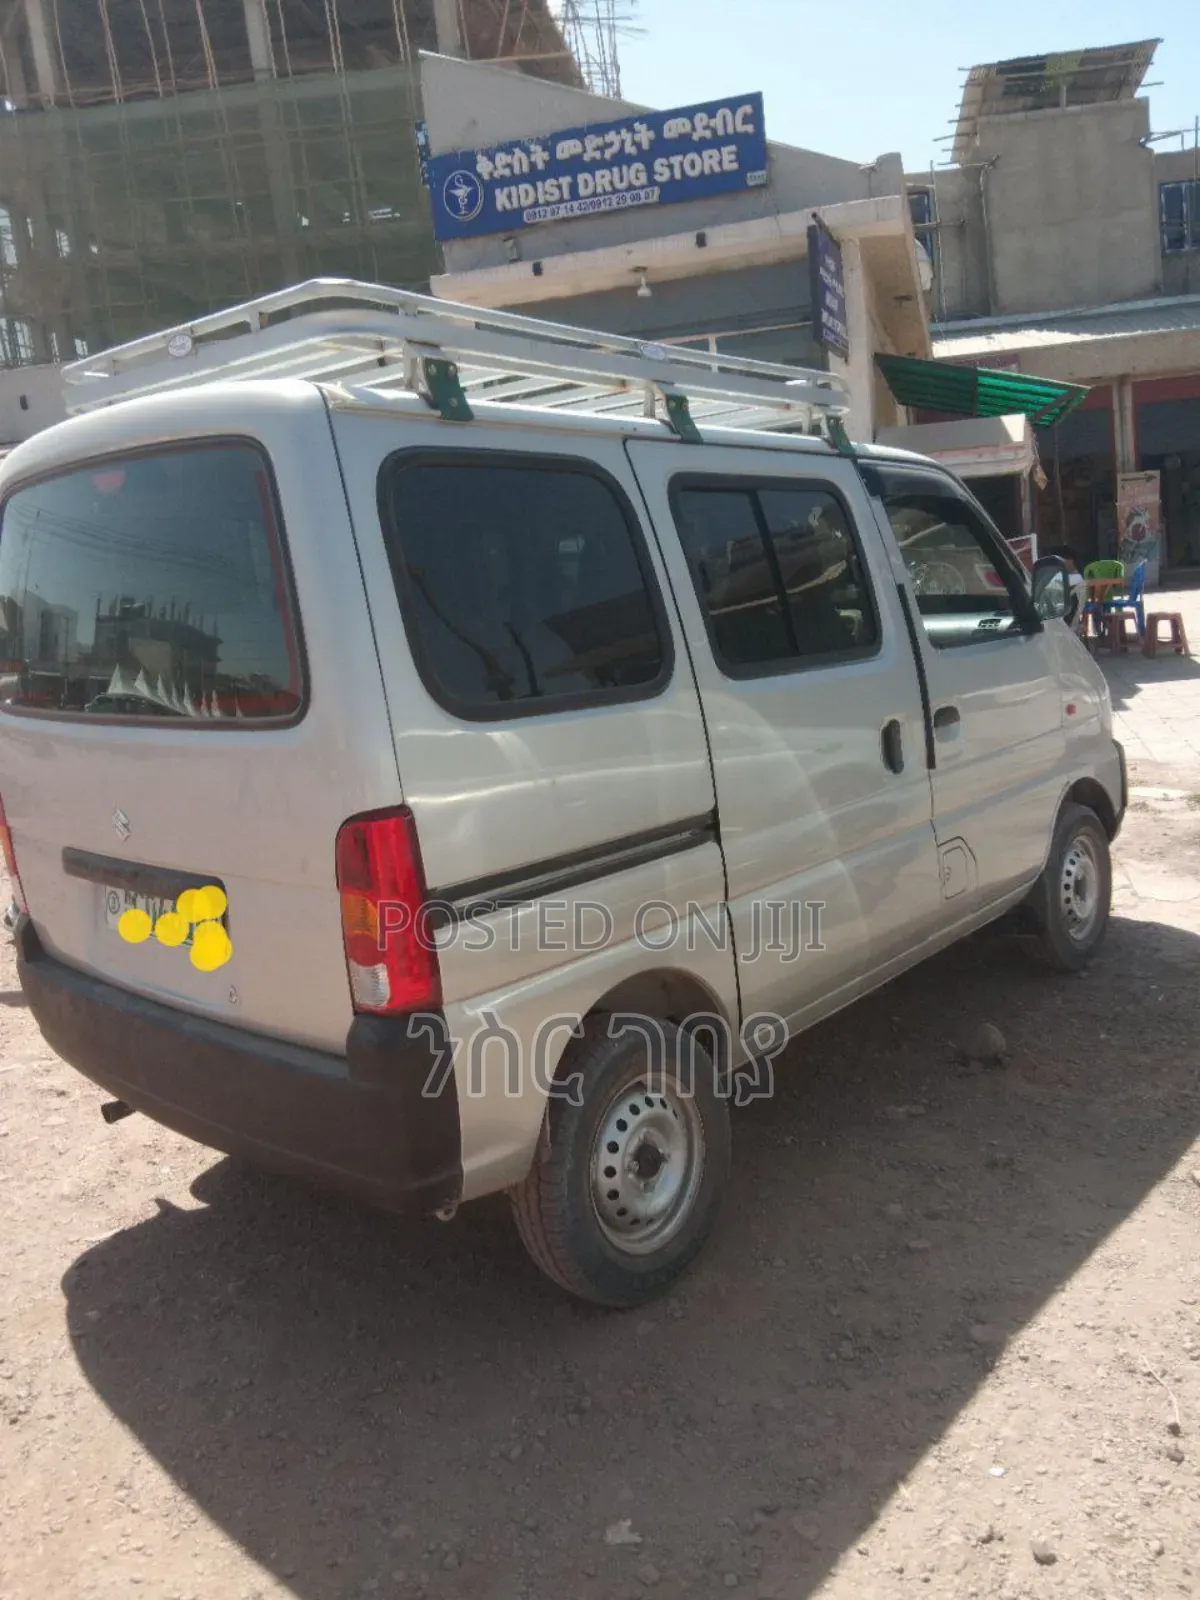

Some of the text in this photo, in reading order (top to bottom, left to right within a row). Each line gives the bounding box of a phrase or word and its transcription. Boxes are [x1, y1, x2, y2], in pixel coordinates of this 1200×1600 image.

[495, 176, 572, 212] KIDIST
[577, 161, 649, 199] DRUG
[653, 144, 740, 183] STORE
